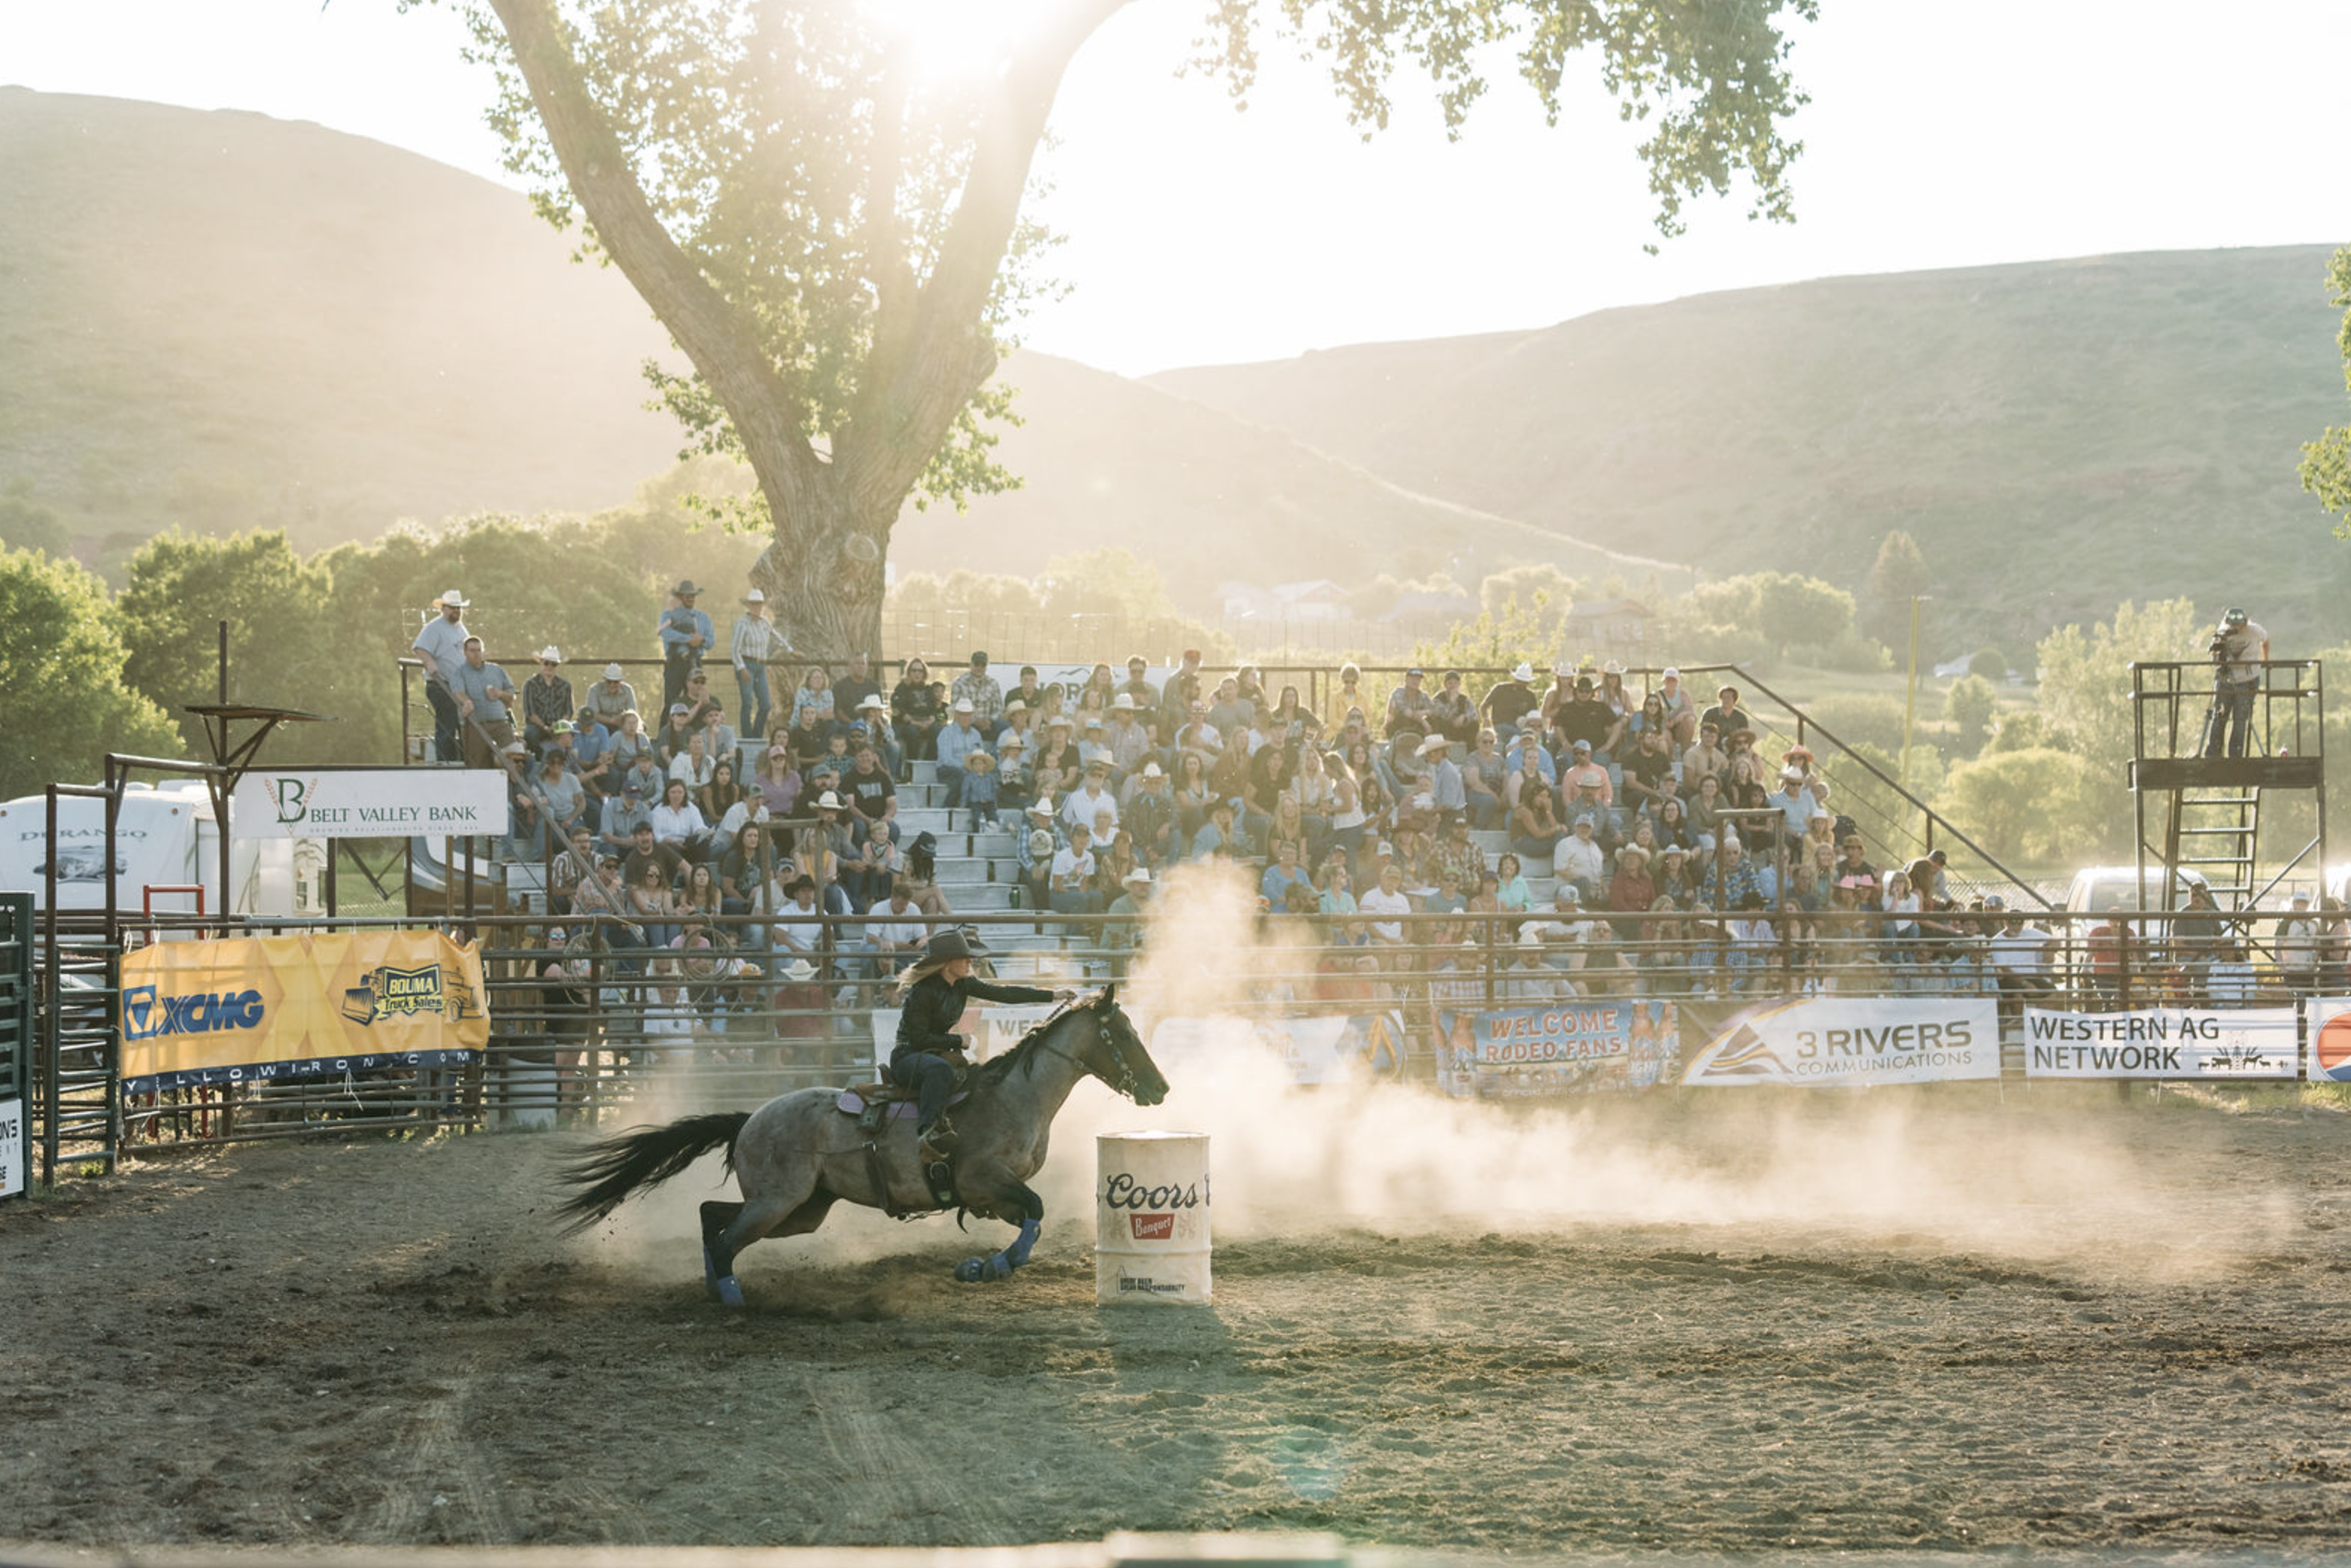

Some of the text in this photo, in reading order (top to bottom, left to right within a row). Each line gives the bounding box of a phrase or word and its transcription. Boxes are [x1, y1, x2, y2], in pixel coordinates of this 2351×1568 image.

[310, 806, 478, 823] BELT VALLEY BANK
[389, 976, 435, 994] BOUMA
[155, 989, 264, 1037] XCMG
[385, 995, 442, 1011] Truck Sales
[1491, 1009, 1619, 1041] WELCOME
[2030, 1016, 2219, 1040] WESTERN AG
[1486, 1042, 1556, 1063] RODEO
[1565, 1037, 1622, 1057] FANS
[1796, 1019, 1972, 1058] 3 RIVERS
[1796, 1051, 1972, 1075] COMMUNICATIONS
[2034, 1046, 2180, 1070] NETWORK
[1106, 1173, 1199, 1209] Coors
[1135, 1216, 1171, 1237] Banquet
